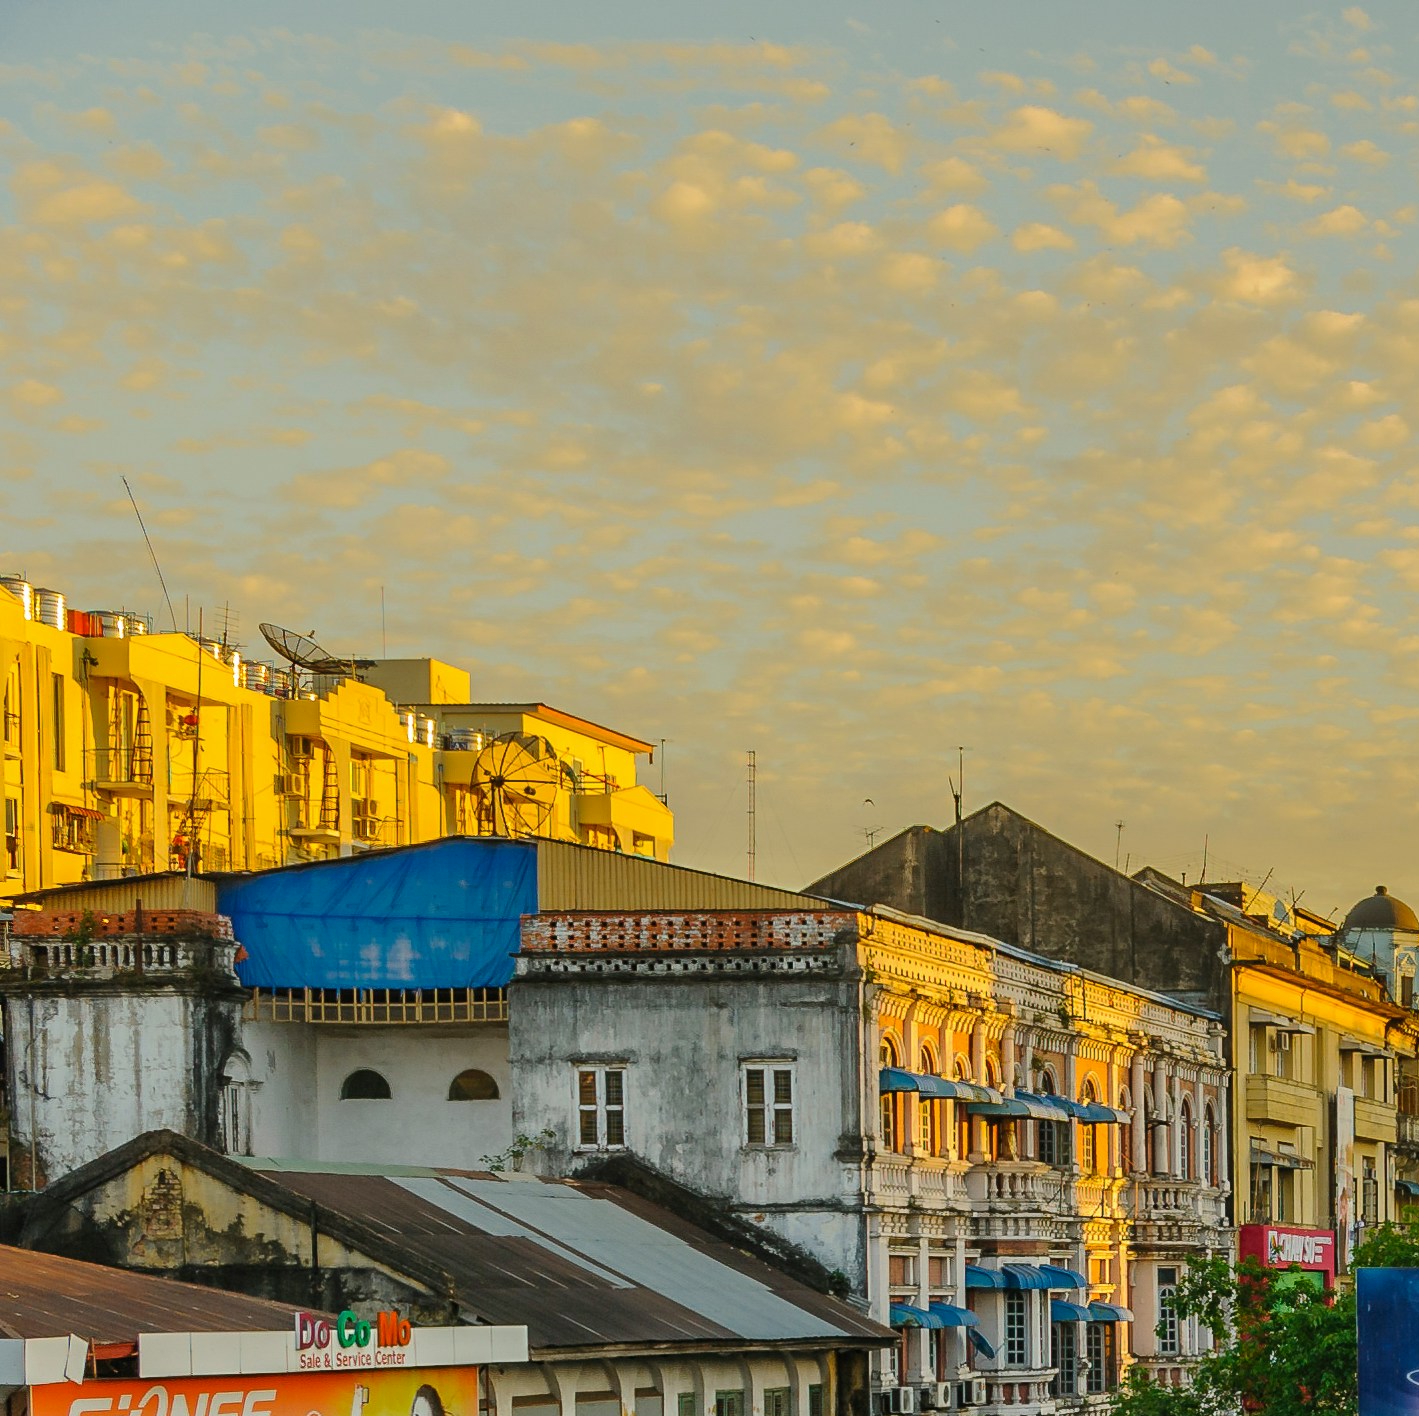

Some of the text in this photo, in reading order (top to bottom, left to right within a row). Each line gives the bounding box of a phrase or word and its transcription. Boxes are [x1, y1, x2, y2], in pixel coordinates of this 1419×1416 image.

[295, 1310, 411, 1351] Do Co Mo
[300, 1350, 406, 1369] Sale & Service Center
